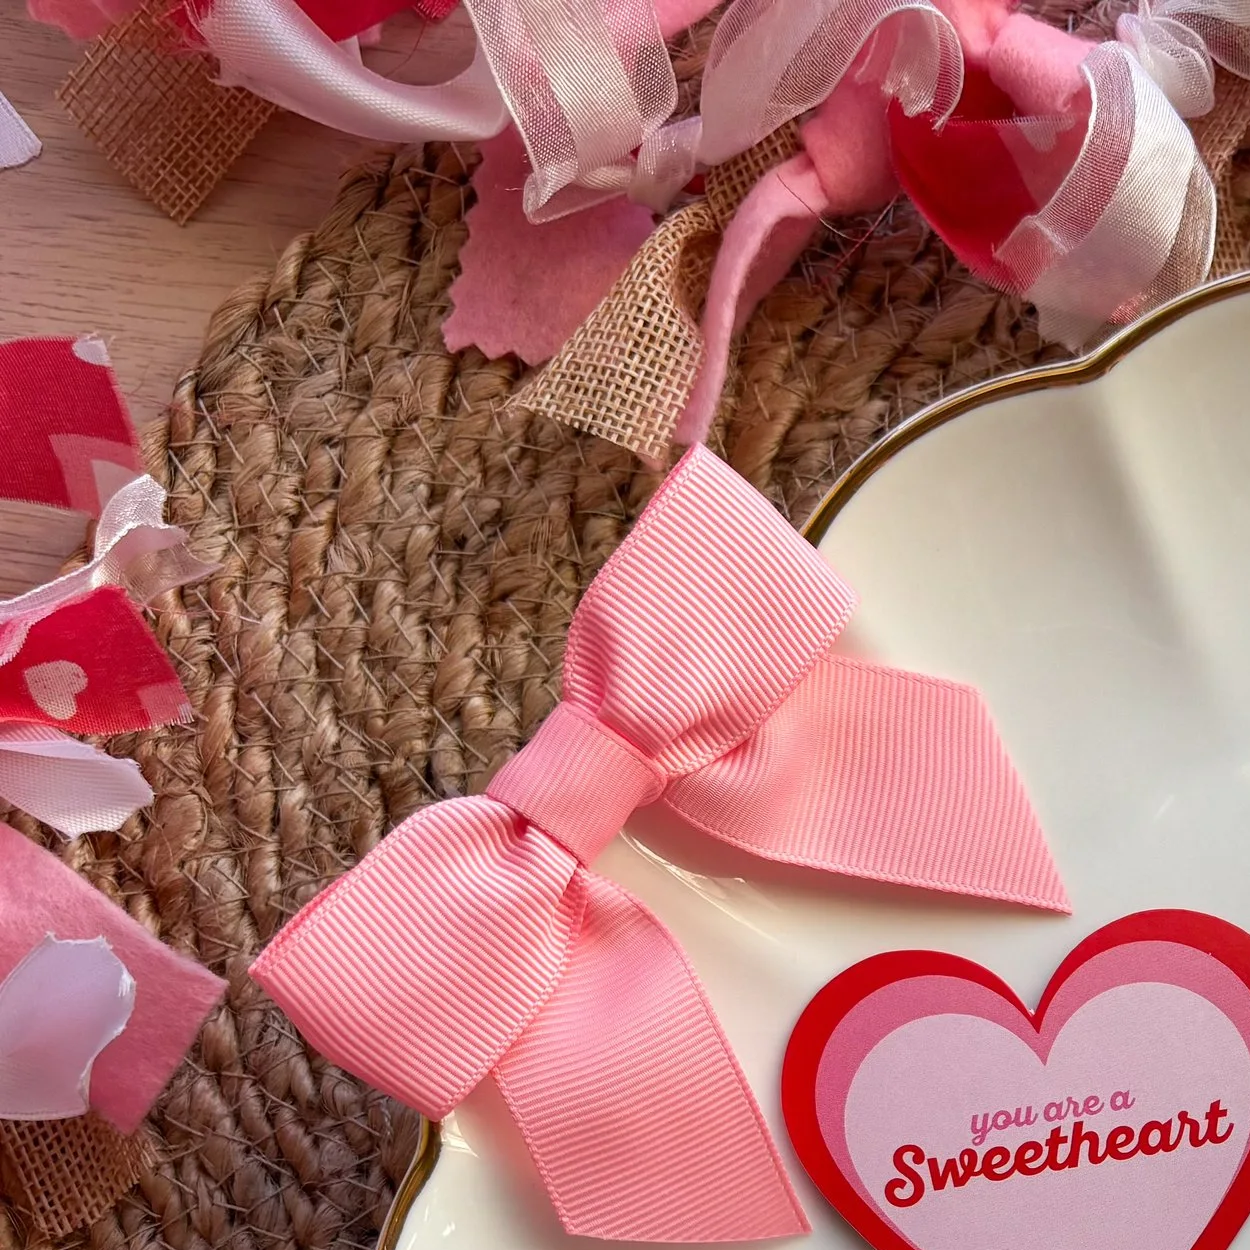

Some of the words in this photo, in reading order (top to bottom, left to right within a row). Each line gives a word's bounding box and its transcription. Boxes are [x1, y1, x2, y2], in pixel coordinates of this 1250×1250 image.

[884, 1098, 1235, 1208] Sweetheart
[970, 1103, 1038, 1147] you
[1043, 1094, 1105, 1122] are
[1110, 1088, 1136, 1112] a
